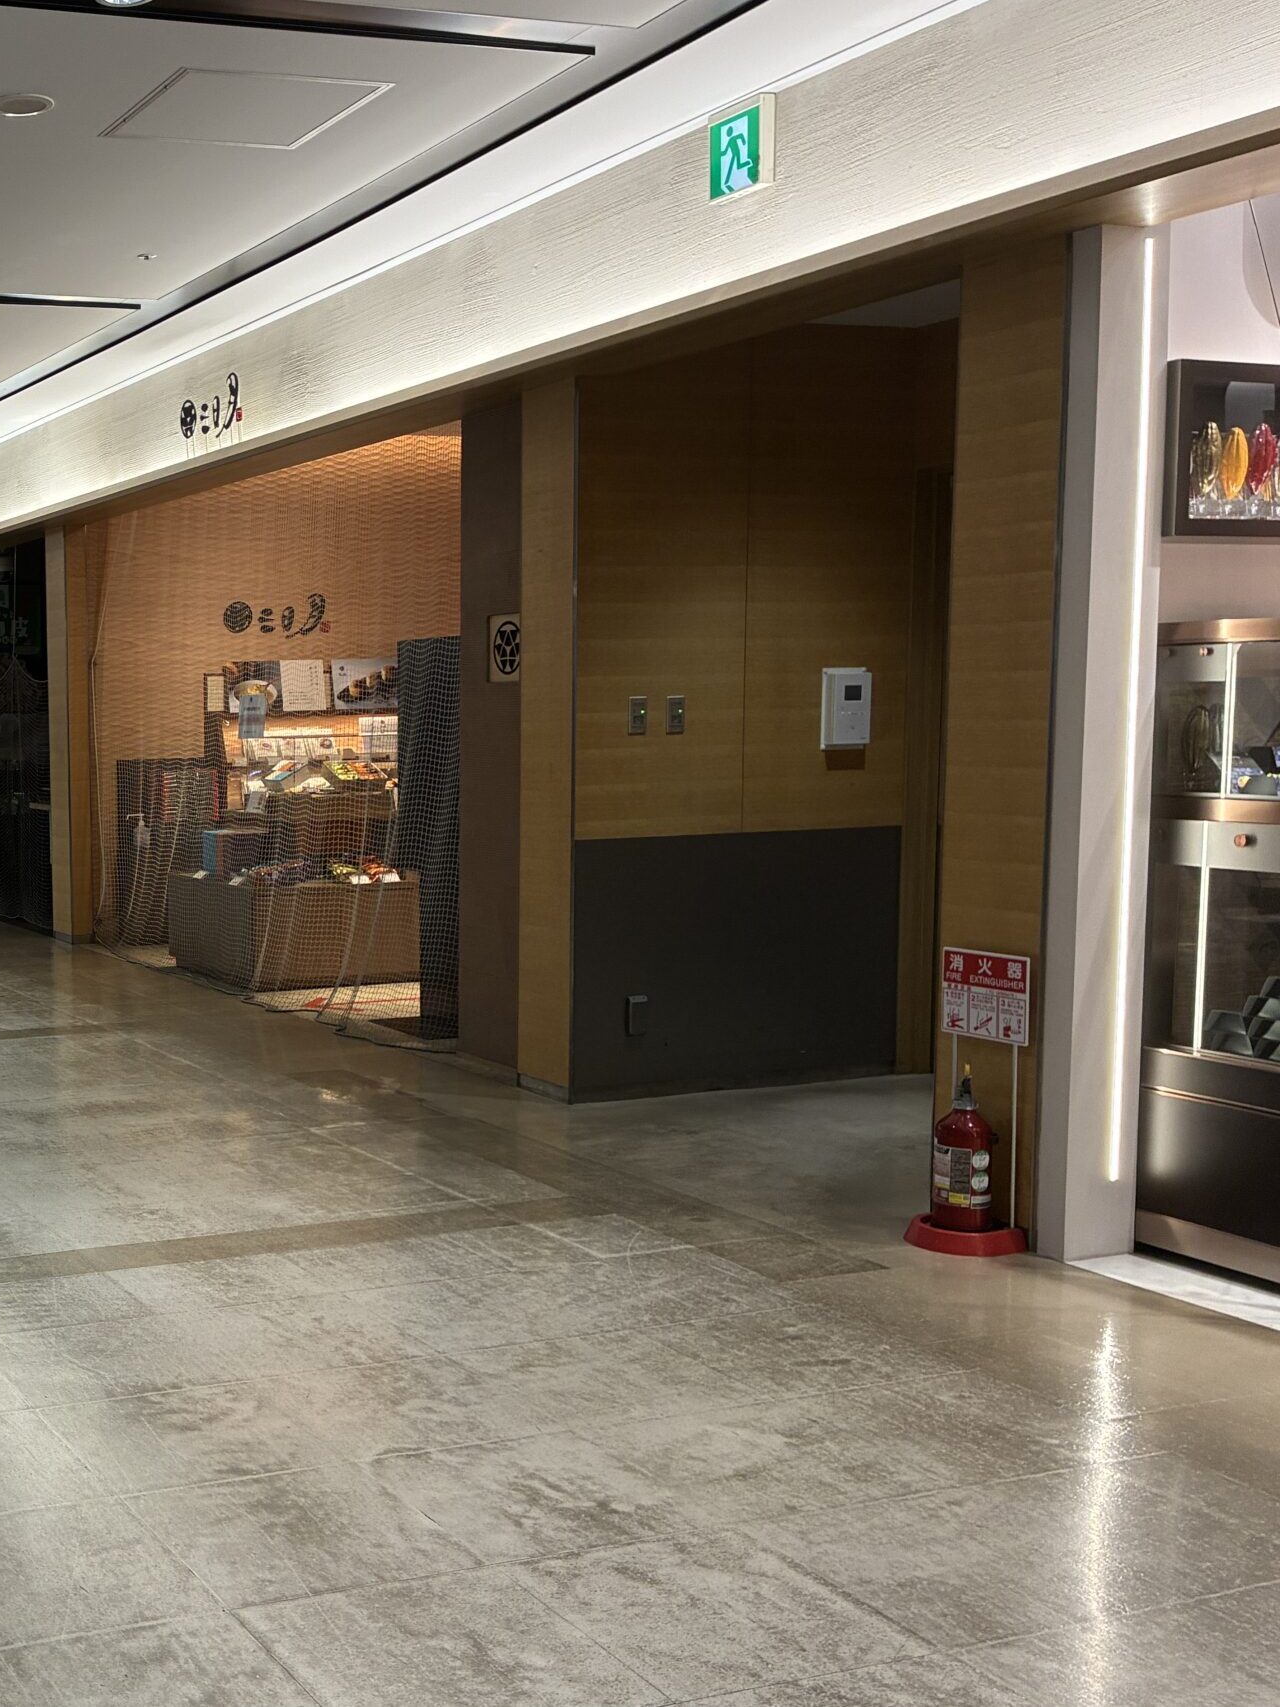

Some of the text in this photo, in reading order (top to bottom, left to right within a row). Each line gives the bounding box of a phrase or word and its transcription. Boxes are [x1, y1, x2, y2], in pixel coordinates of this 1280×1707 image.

[949, 953, 1023, 980] 消火器
[945, 971, 962, 981] FIRE
[969, 975, 1025, 990] EXTINGUISHER
